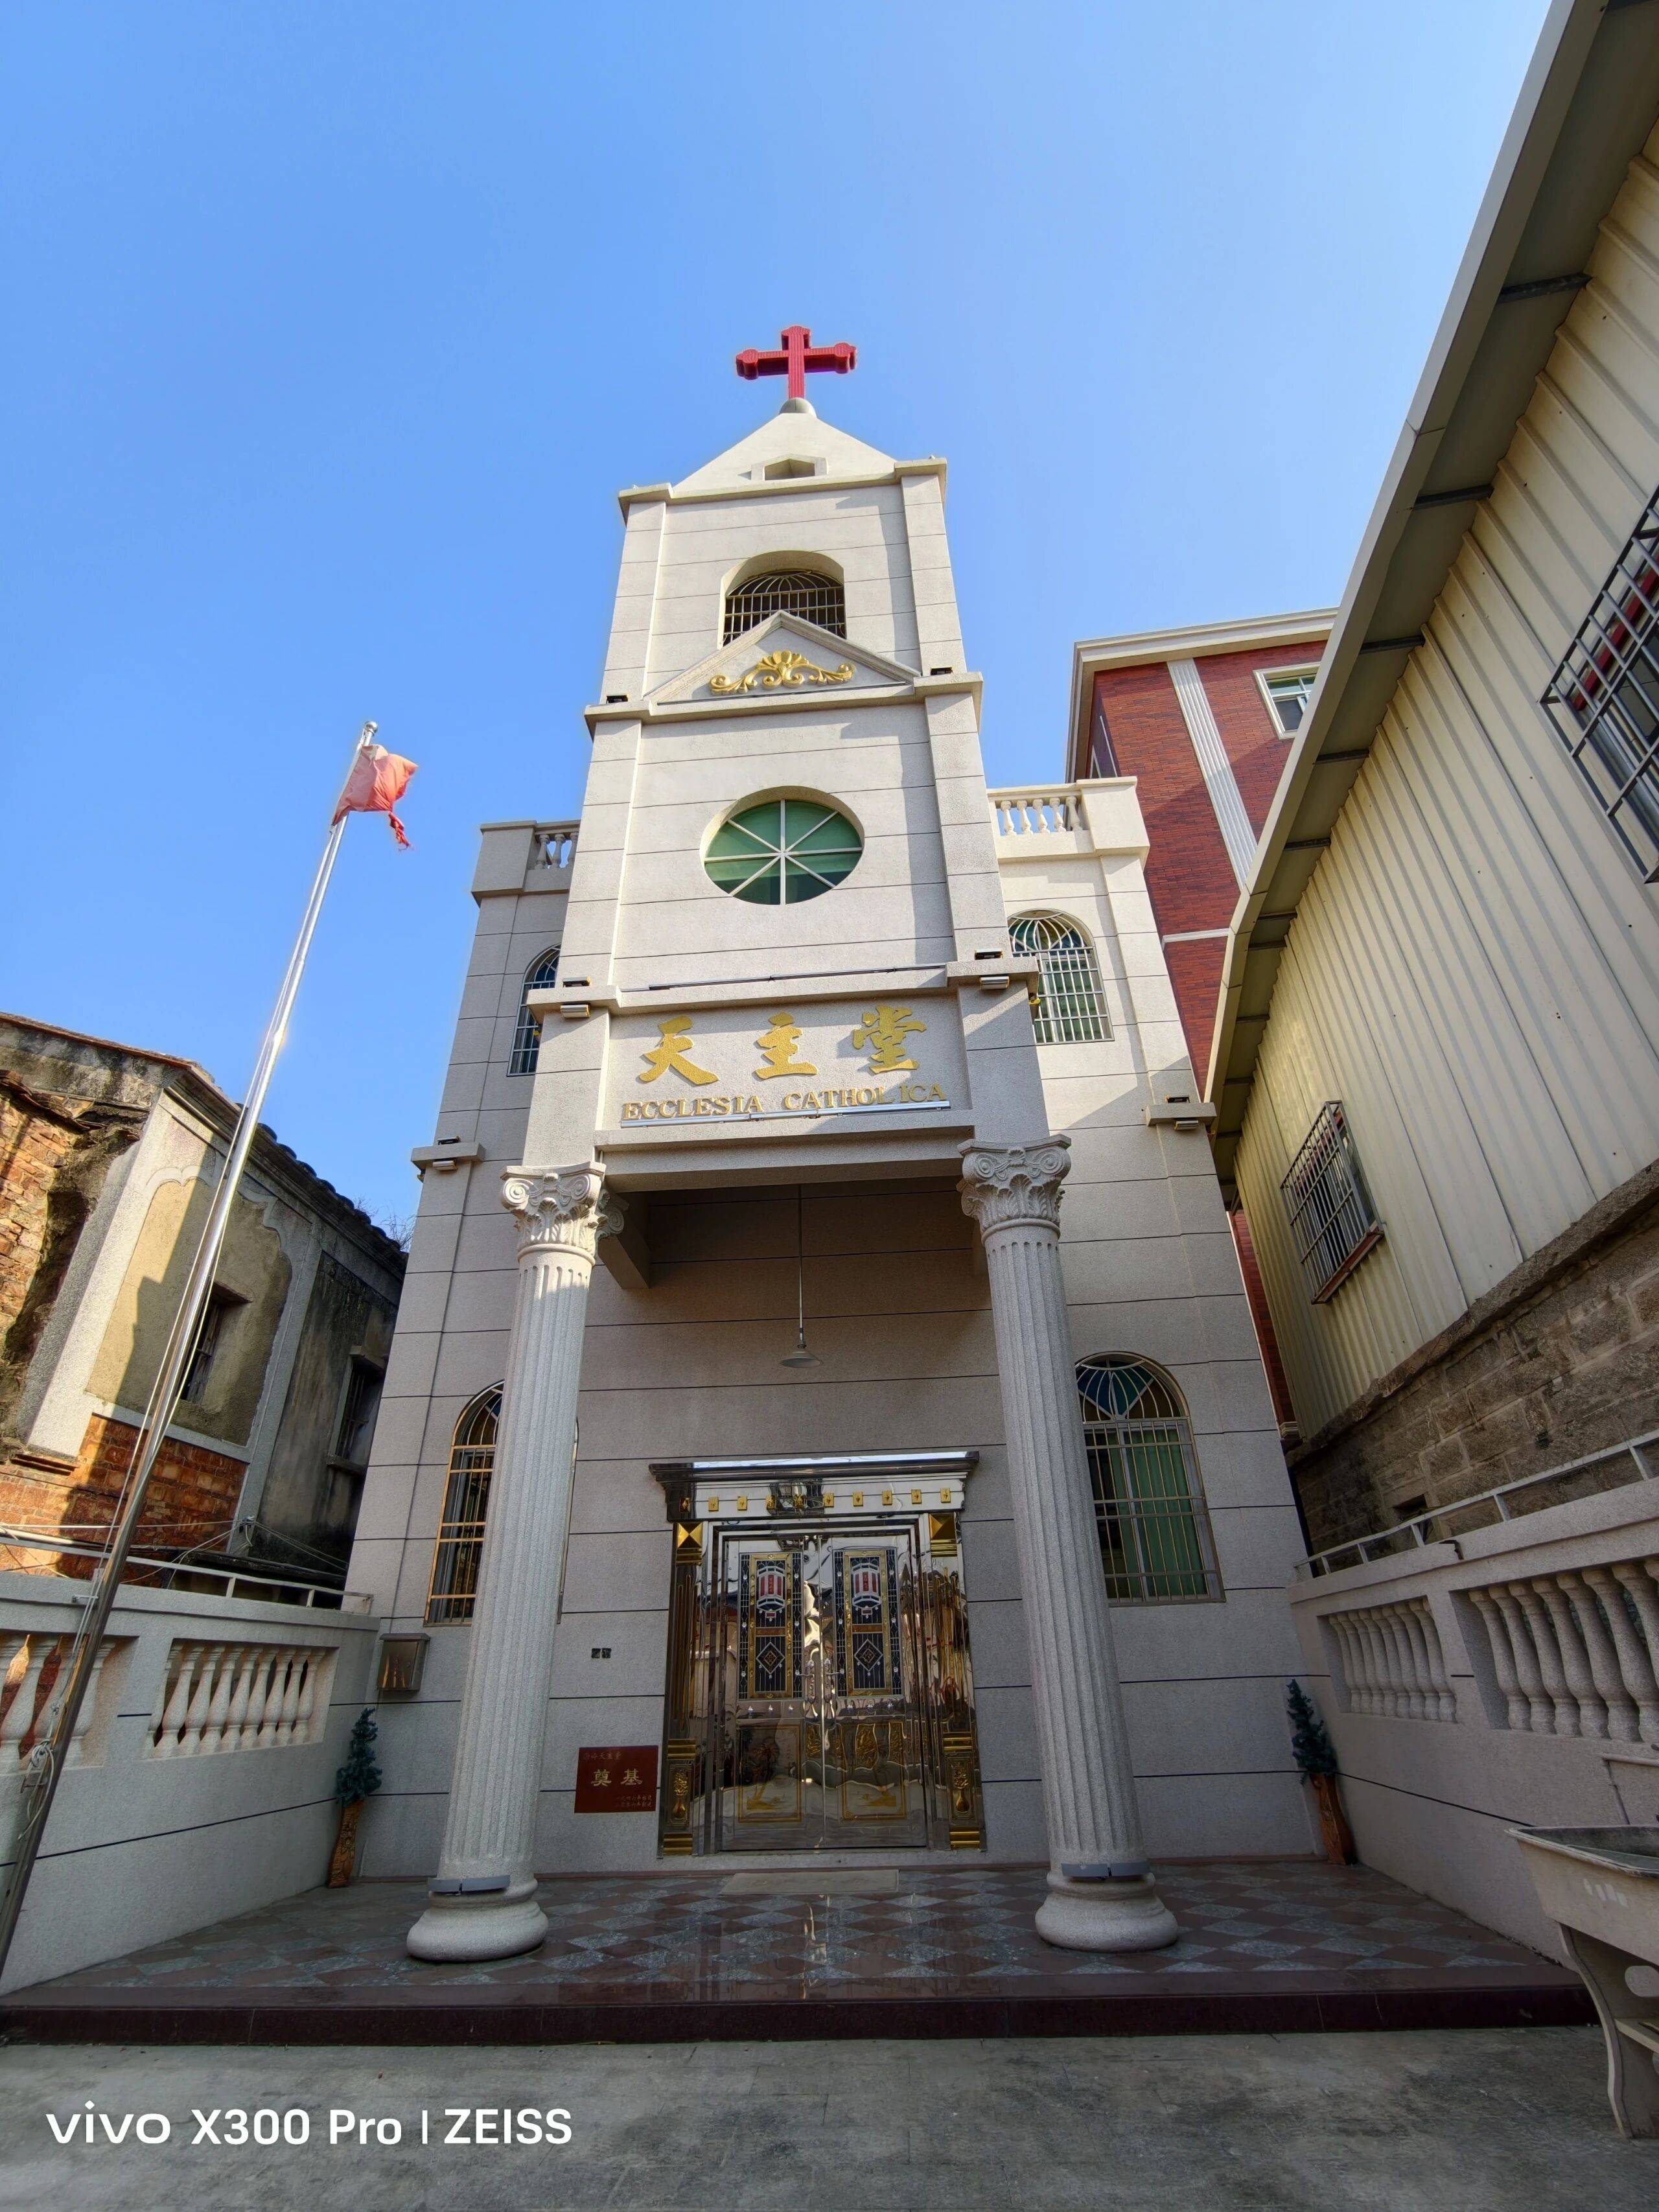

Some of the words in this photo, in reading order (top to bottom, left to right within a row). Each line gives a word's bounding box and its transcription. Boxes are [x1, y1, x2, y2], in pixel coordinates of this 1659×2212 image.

[638, 1005, 927, 1085] 天主堂
[623, 1095, 763, 1120] ECCLESIA
[783, 1083, 947, 1110] CATHOLICA
[590, 1768, 643, 1787] 奠基
